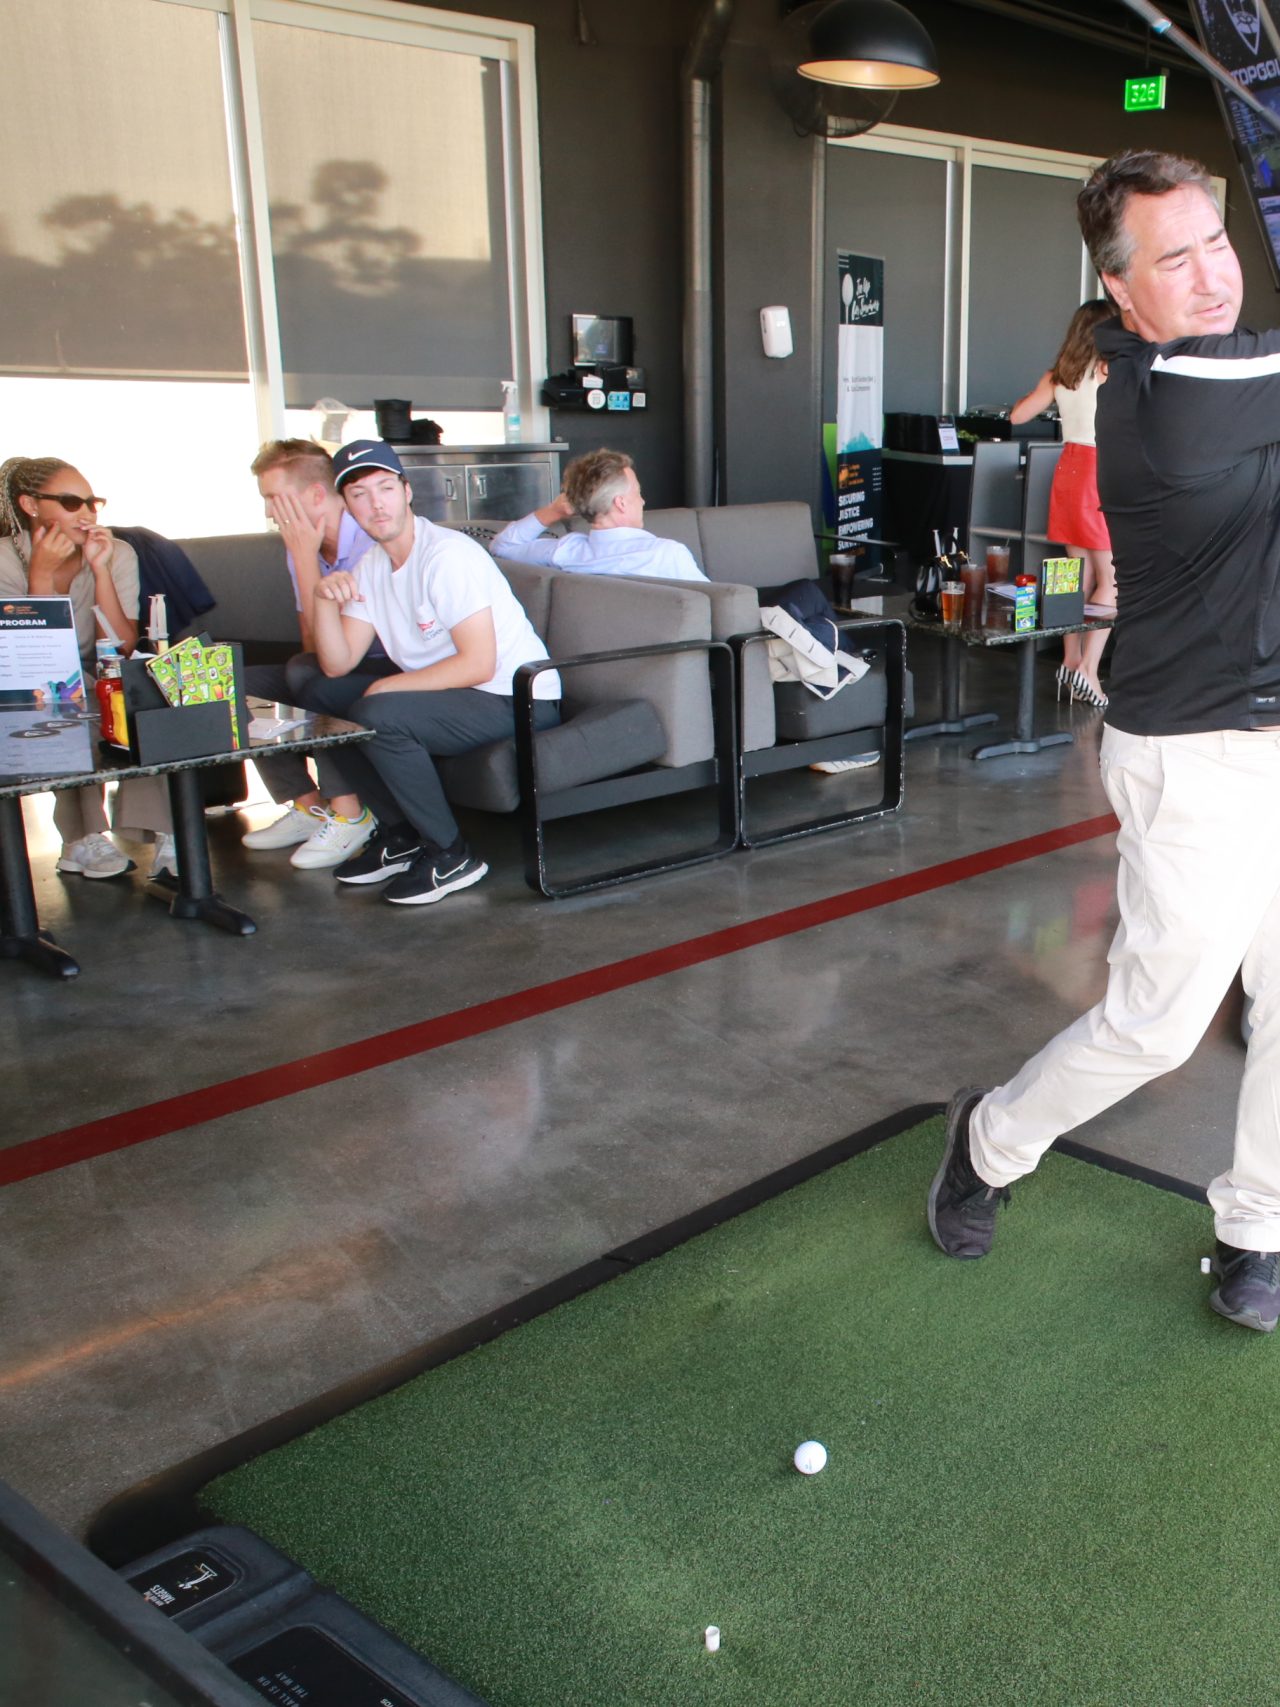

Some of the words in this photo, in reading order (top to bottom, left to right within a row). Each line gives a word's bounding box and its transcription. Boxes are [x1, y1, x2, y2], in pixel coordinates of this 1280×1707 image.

[1131, 82, 1156, 103] 326
[838, 490, 866, 507] SECURING
[838, 506, 860, 521] JUSTICE
[838, 517, 874, 536] EMPOWERING
